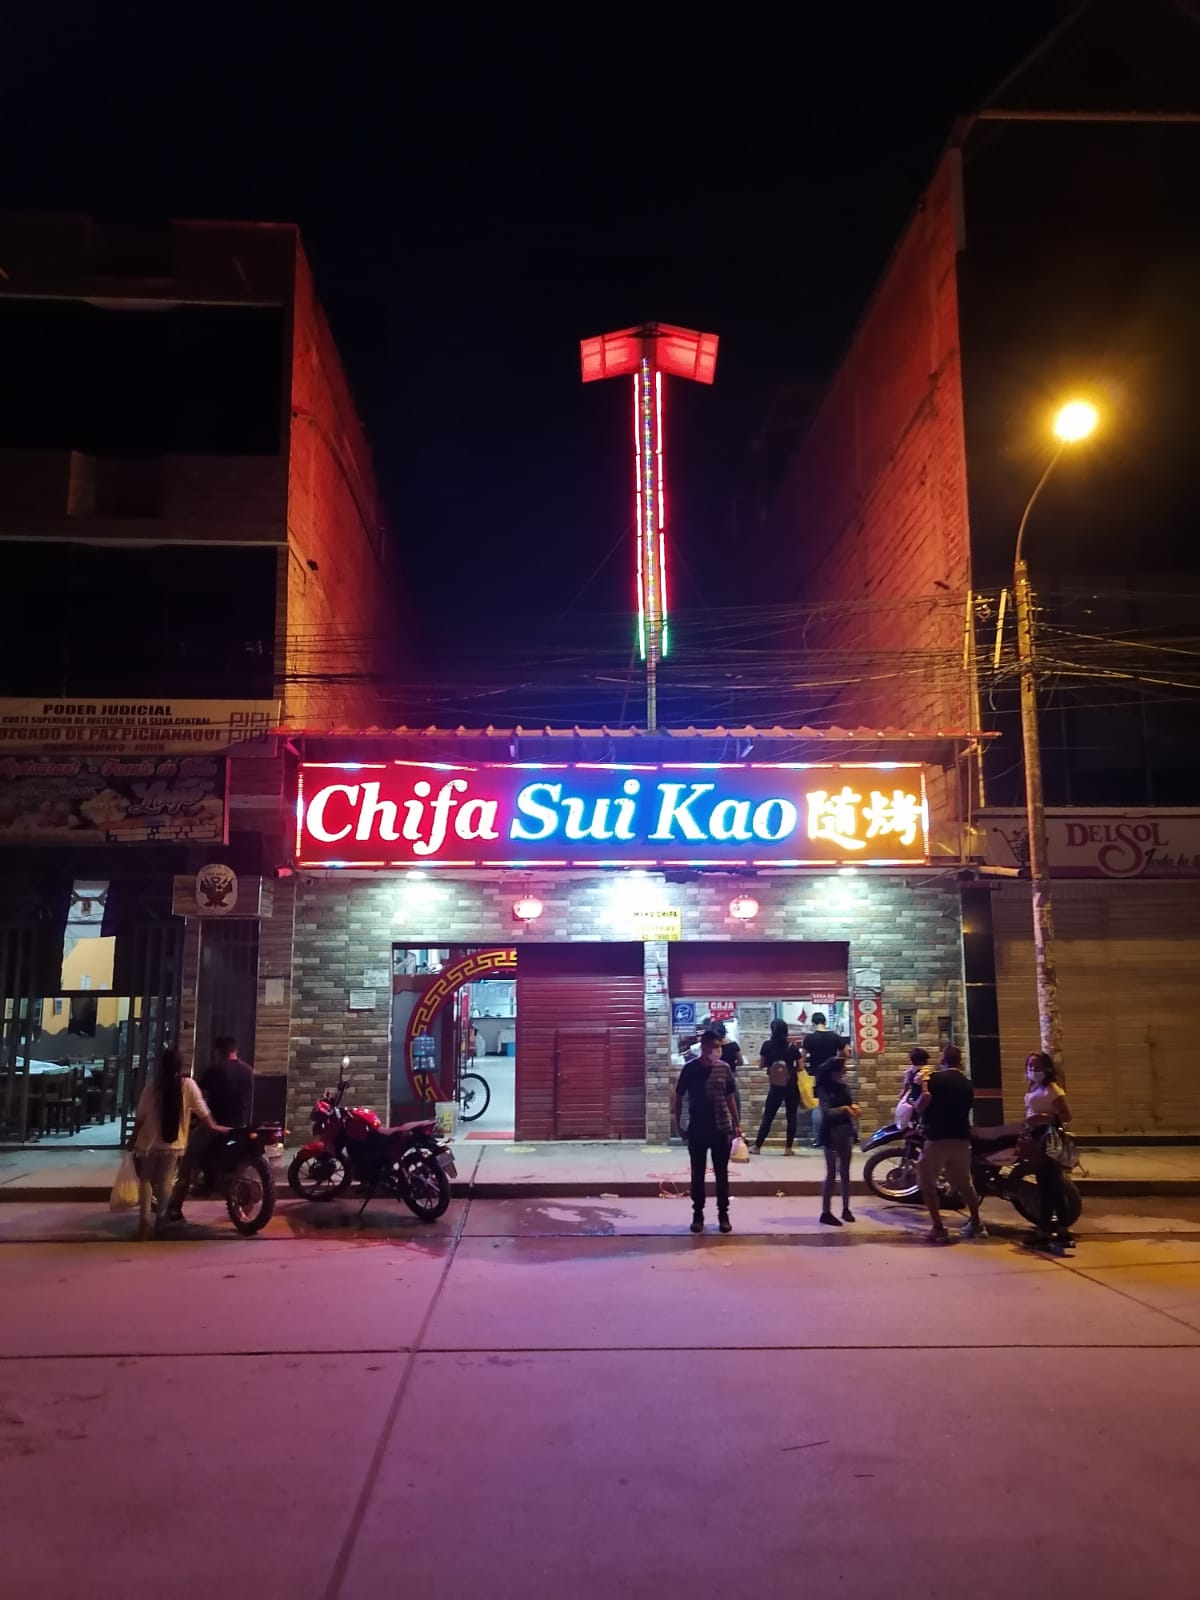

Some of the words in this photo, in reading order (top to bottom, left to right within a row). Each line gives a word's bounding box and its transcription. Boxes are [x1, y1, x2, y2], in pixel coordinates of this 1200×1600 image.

[43, 704, 97, 715] PODER
[100, 705, 172, 716] JUDICIAL
[65, 728, 84, 740] DE
[88, 728, 119, 740] PAZ
[121, 728, 220, 741] PICHANAQUI
[306, 779, 499, 856] Chifa
[509, 778, 641, 841] Sui
[647, 783, 798, 841] Kao
[710, 1001, 734, 1009] CAJA
